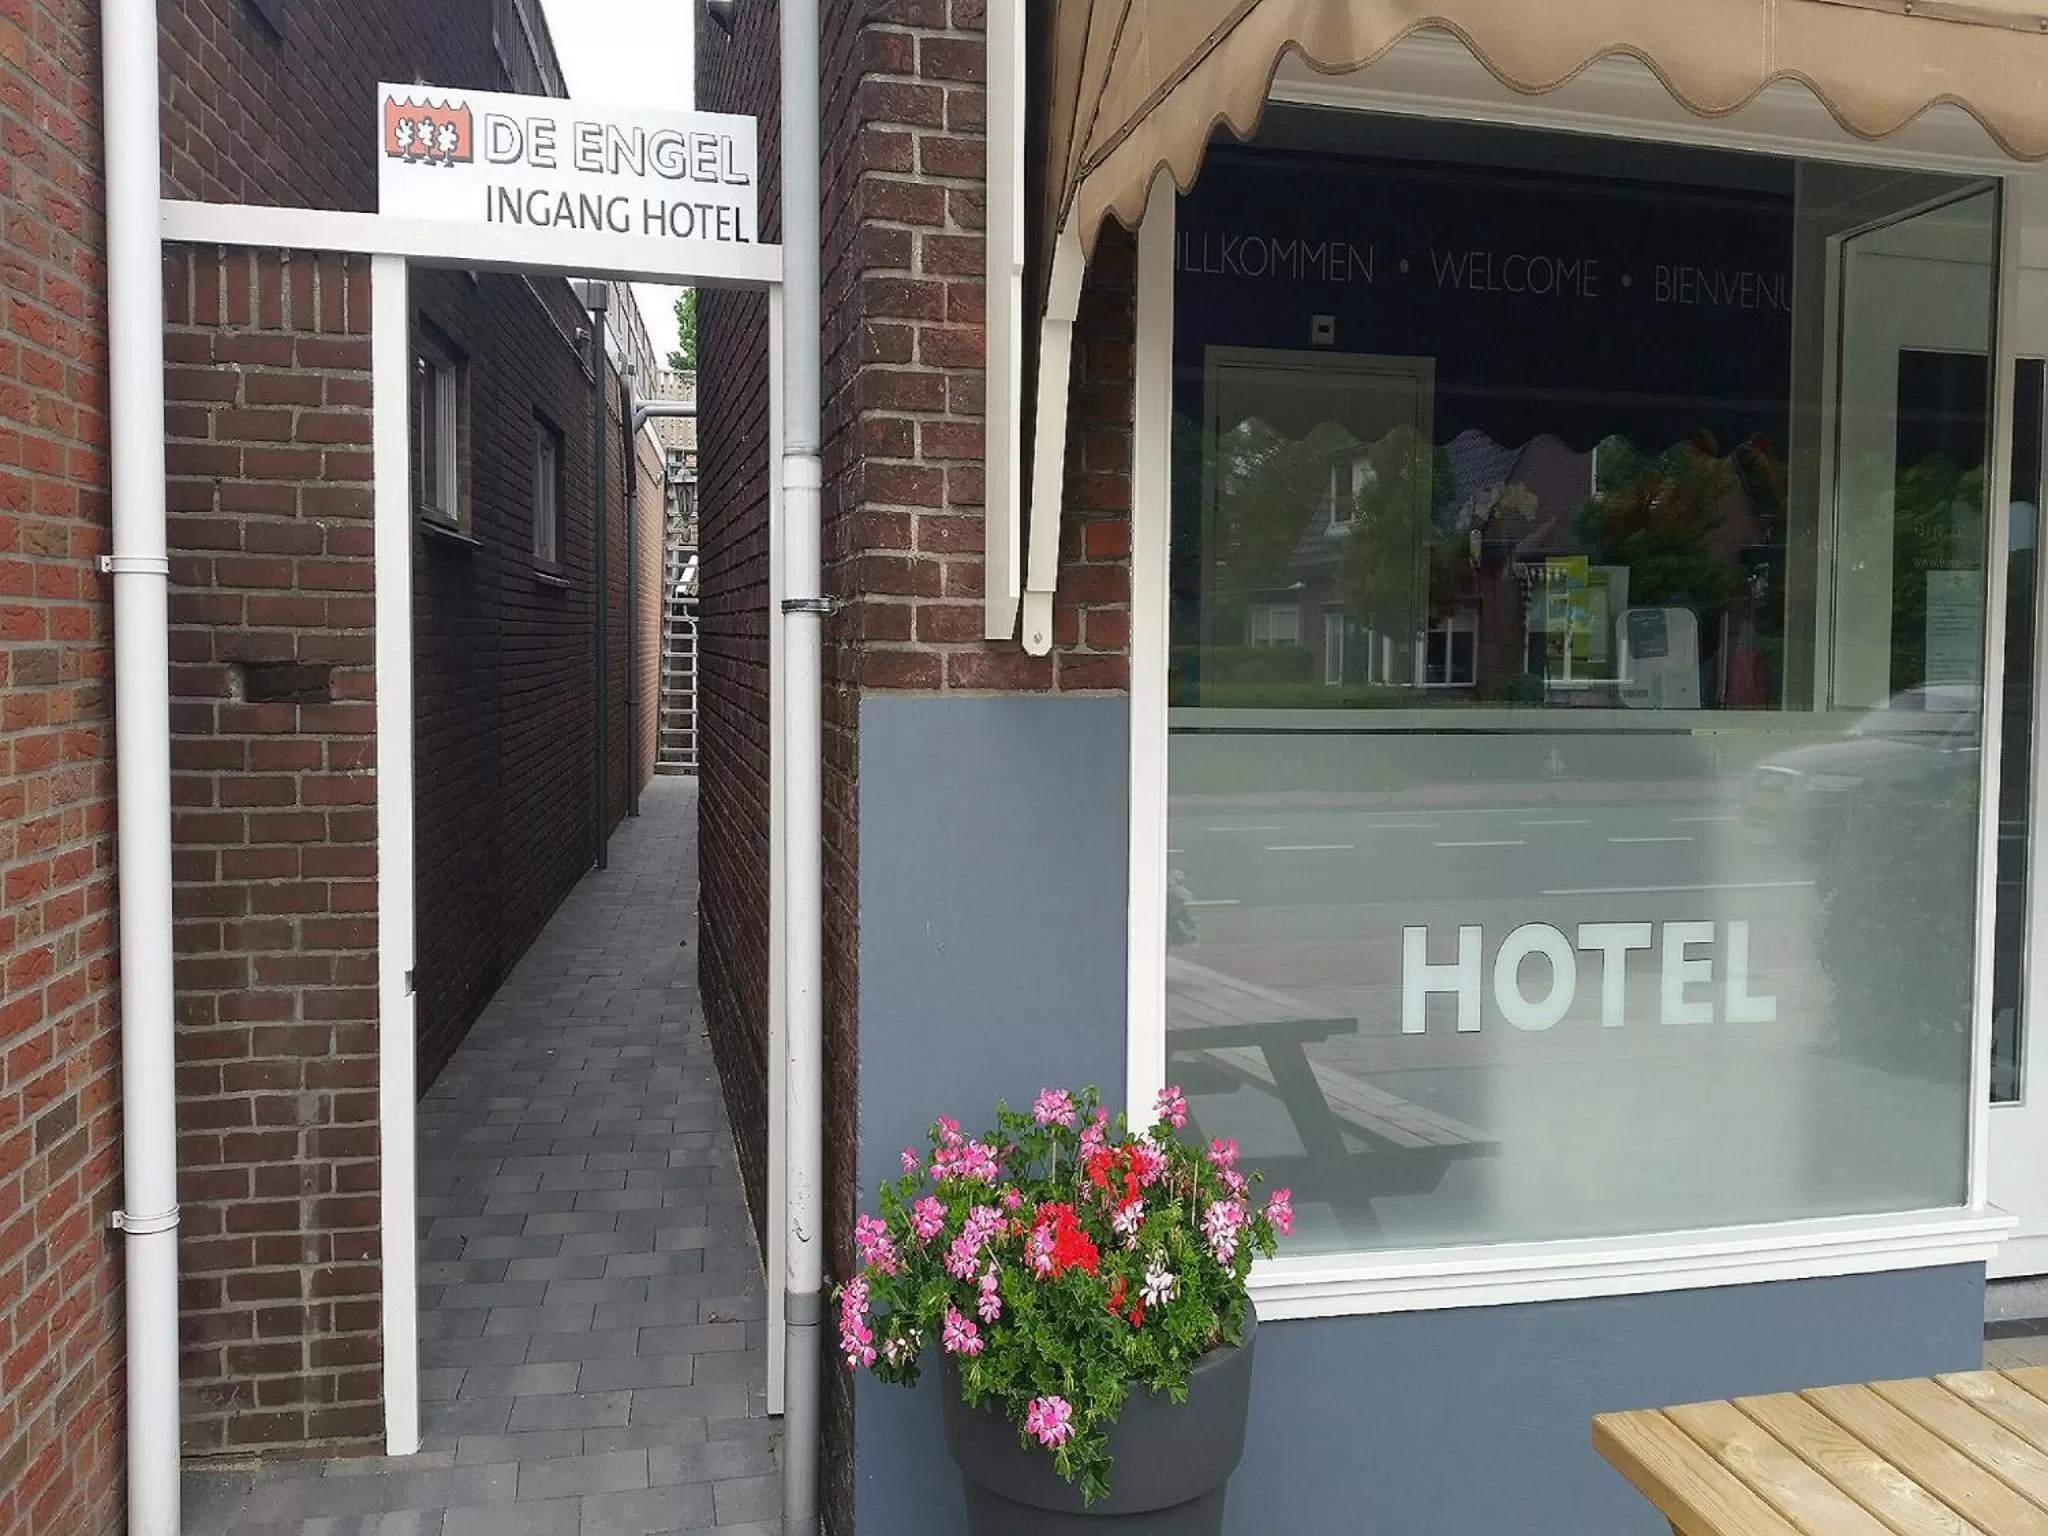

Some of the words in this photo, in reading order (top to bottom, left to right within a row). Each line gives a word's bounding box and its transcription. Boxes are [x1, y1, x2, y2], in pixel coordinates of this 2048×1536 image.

[485, 113, 556, 169] DE
[574, 121, 750, 186] ENGEL
[486, 185, 629, 233] INGANG
[643, 199, 750, 244] HOTEL
[1429, 248, 1600, 297] WELCOME
[1401, 920, 1777, 1035] HOTEL
